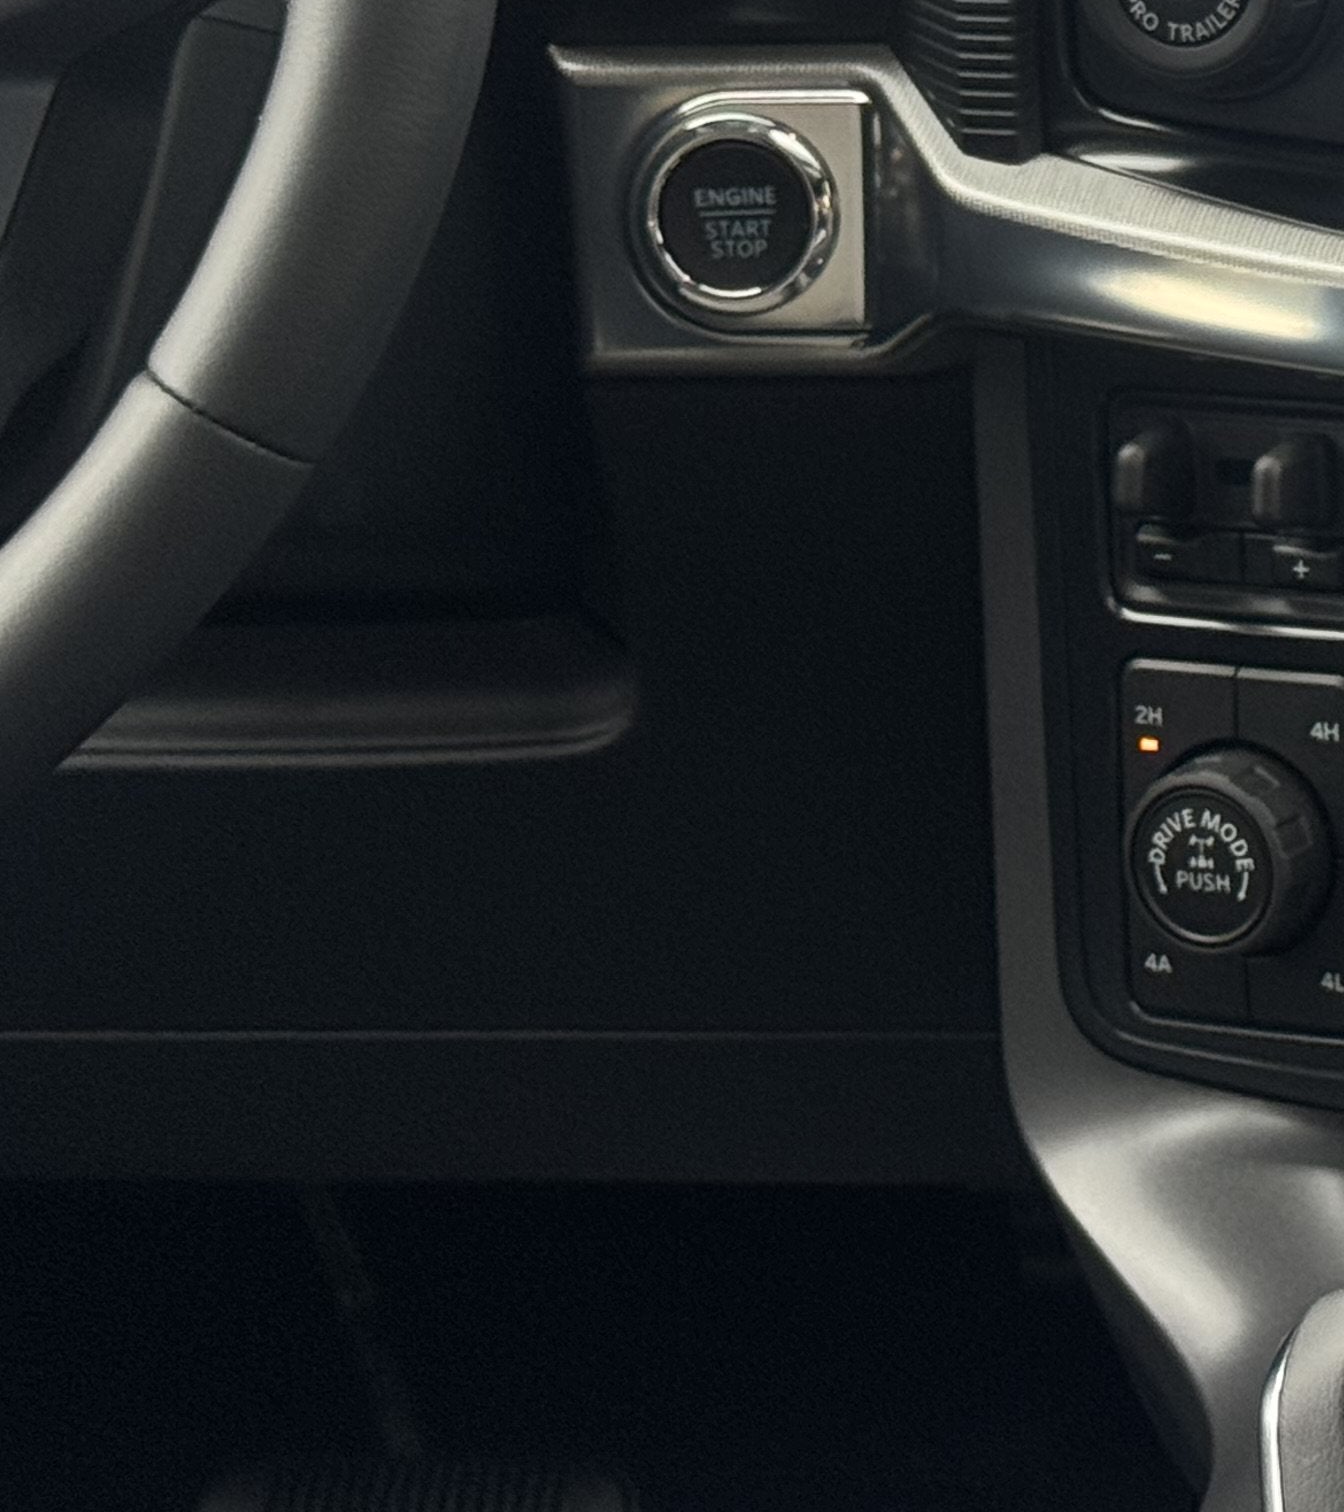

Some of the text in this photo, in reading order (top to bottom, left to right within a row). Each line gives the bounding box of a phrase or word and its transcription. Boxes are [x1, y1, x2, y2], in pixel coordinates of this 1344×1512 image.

[693, 186, 777, 207] ENGINE
[705, 218, 771, 239] START
[711, 239, 767, 260] STOP
[1134, 705, 1163, 727] 2H
[1310, 721, 1340, 742] 4H
[1149, 808, 1256, 872] DRIVE MODE
[1176, 869, 1232, 893] PUSH
[1144, 952, 1172, 974] 4A
